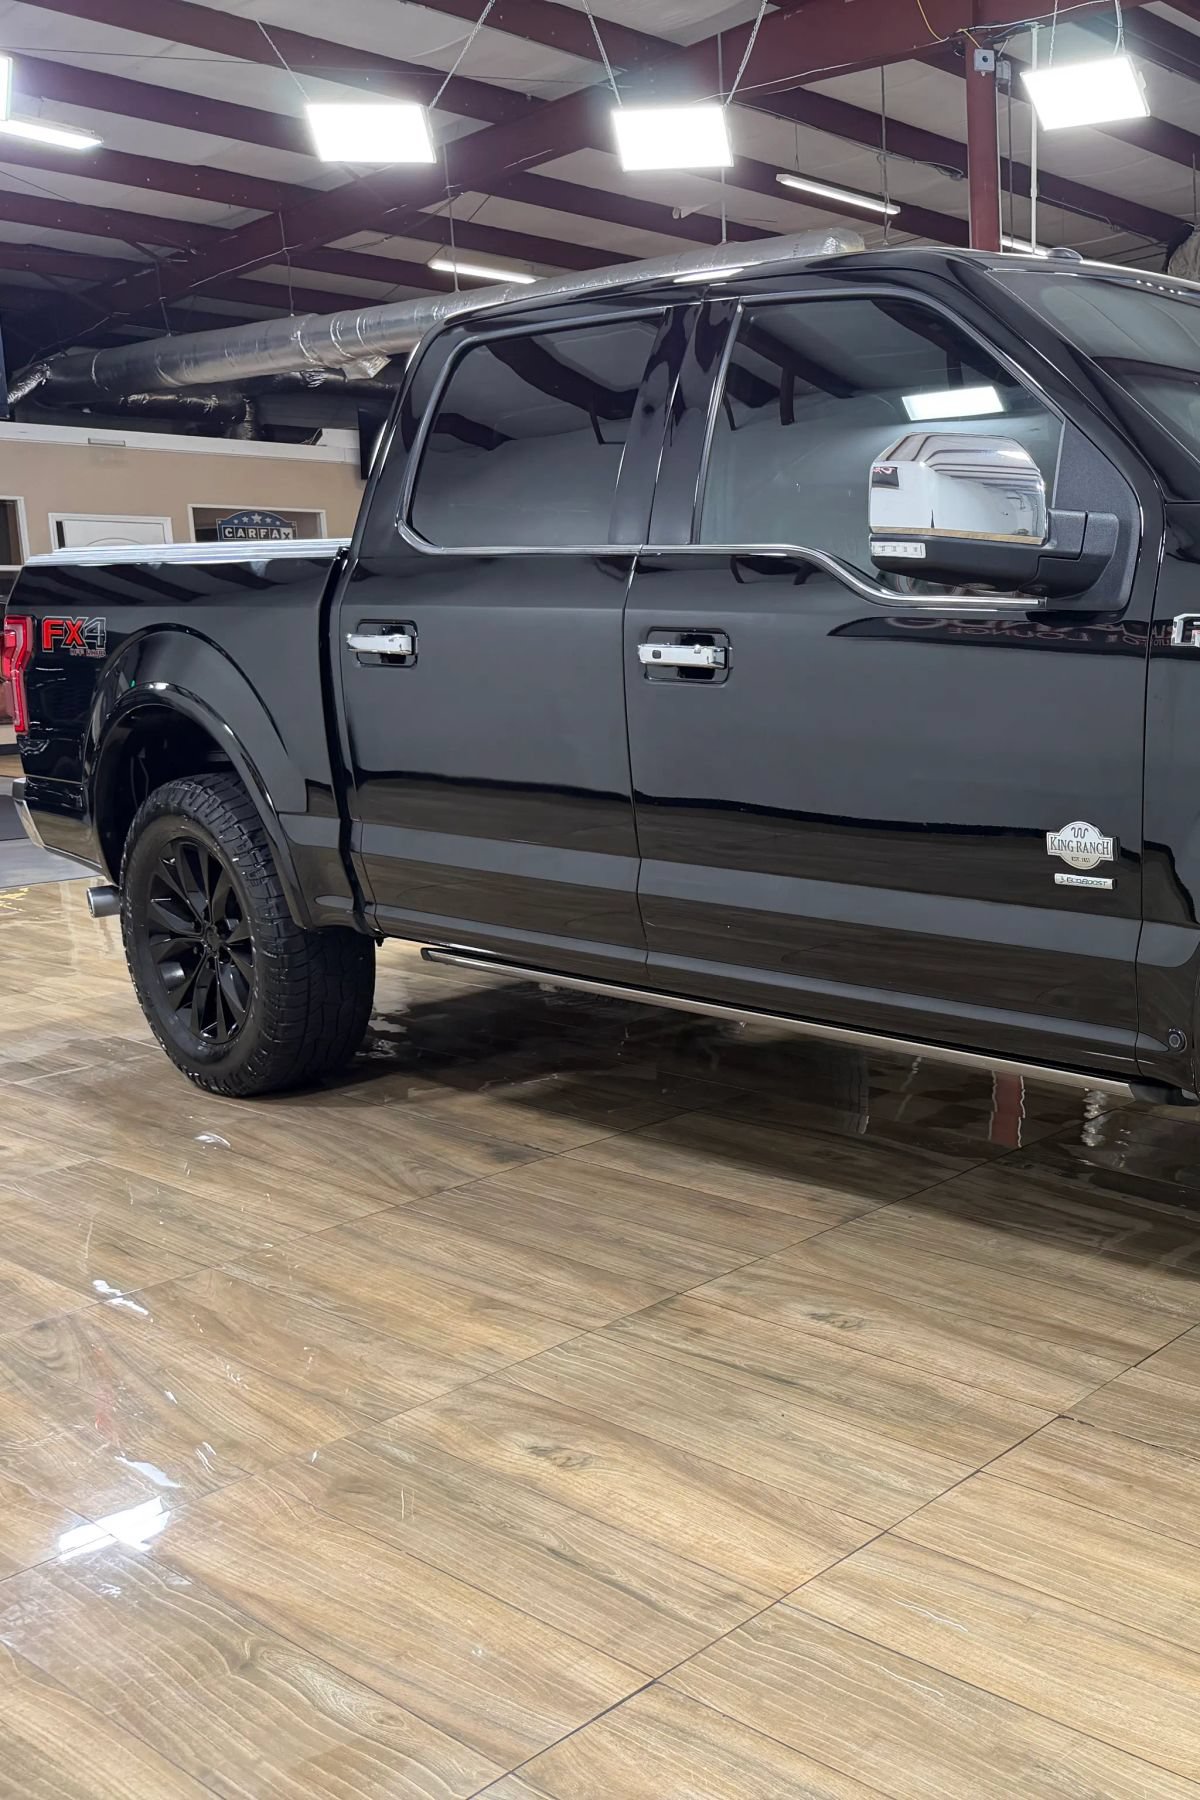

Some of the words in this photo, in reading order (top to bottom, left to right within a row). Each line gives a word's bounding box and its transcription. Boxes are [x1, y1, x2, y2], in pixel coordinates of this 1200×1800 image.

[224, 527, 291, 540] CARFAX
[42, 616, 107, 653] FX4
[1050, 836, 1074, 853] KING
[1076, 840, 1110, 856] RANCH
